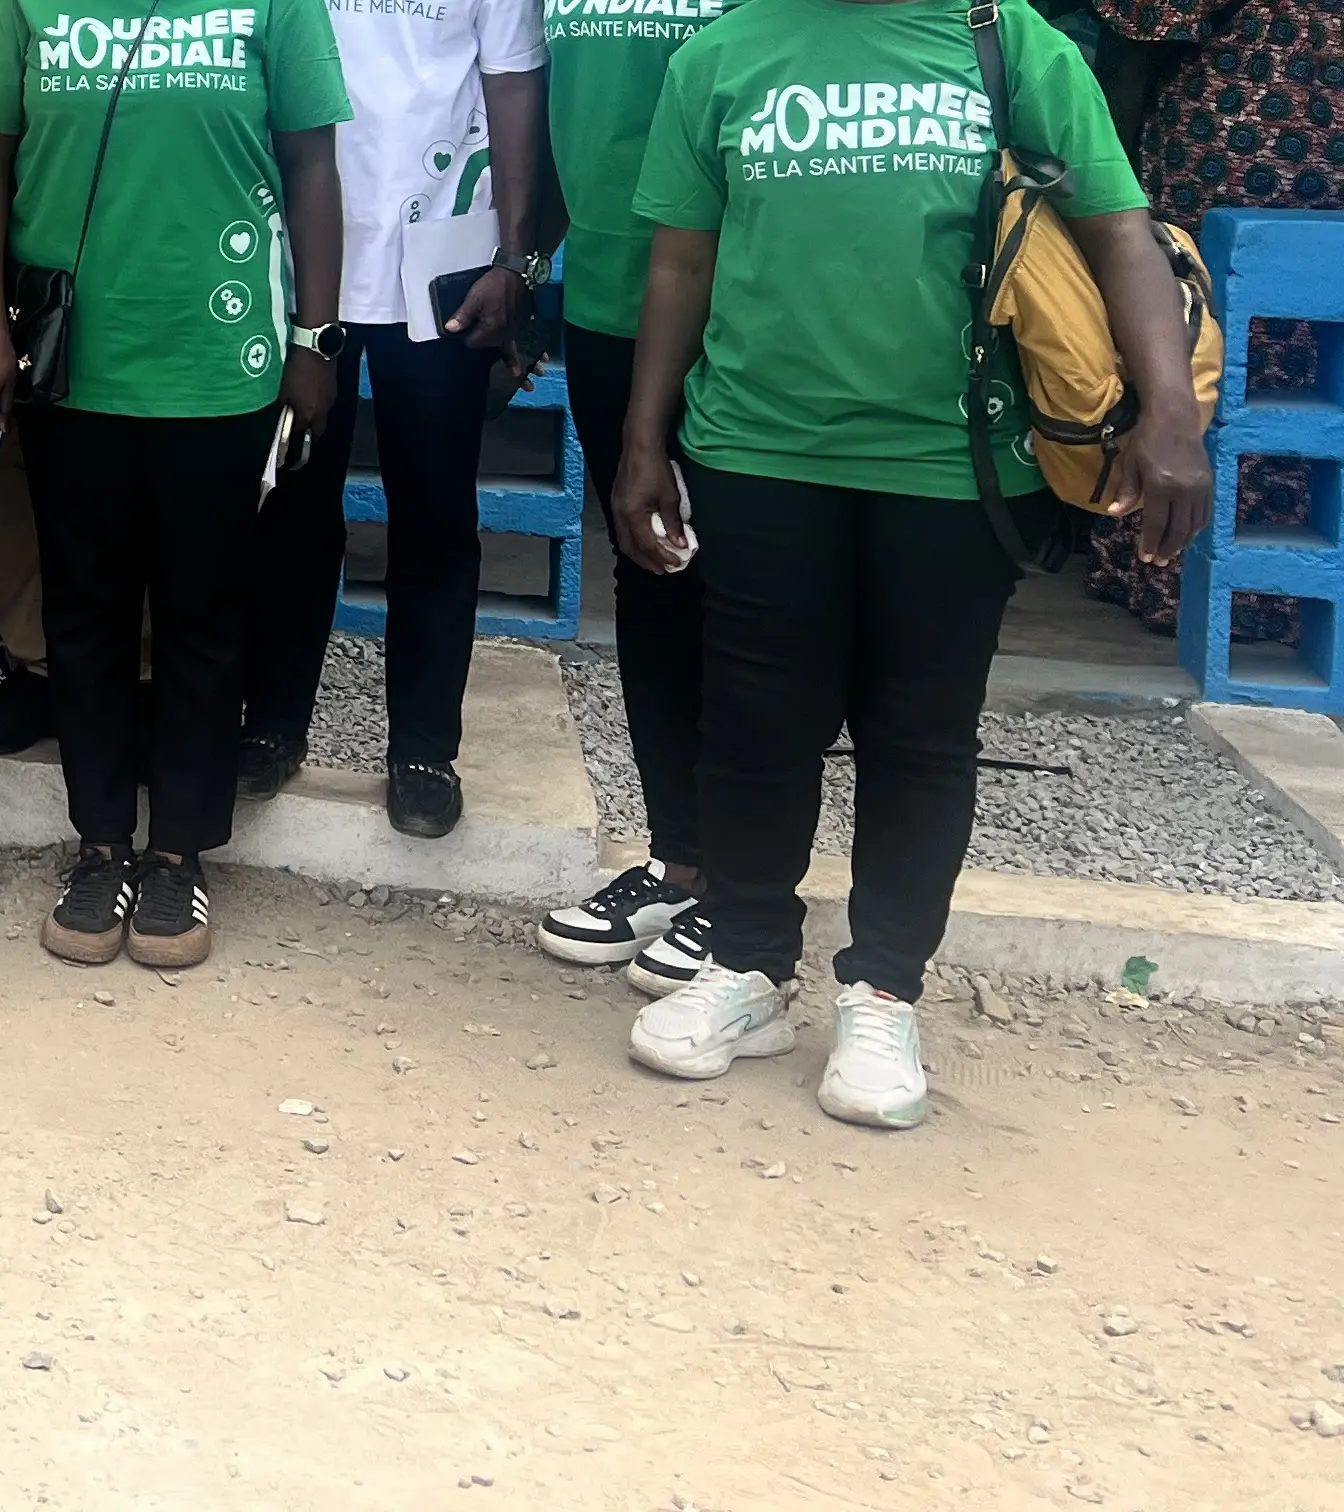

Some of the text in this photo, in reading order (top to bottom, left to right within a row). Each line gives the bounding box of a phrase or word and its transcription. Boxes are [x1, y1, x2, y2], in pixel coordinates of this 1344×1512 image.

[43, 8, 256, 40] JOURNEE
[569, 20, 623, 38] SANTE
[39, 38, 246, 70] MONDIALE
[40, 76, 61, 93] DE
[66, 74, 90, 91] LA
[166, 72, 247, 92] MENTALE
[750, 82, 993, 127] JOURNEE
[740, 116, 987, 157] MONDIALE
[742, 152, 982, 182] DE LA SANTE MENTALE
